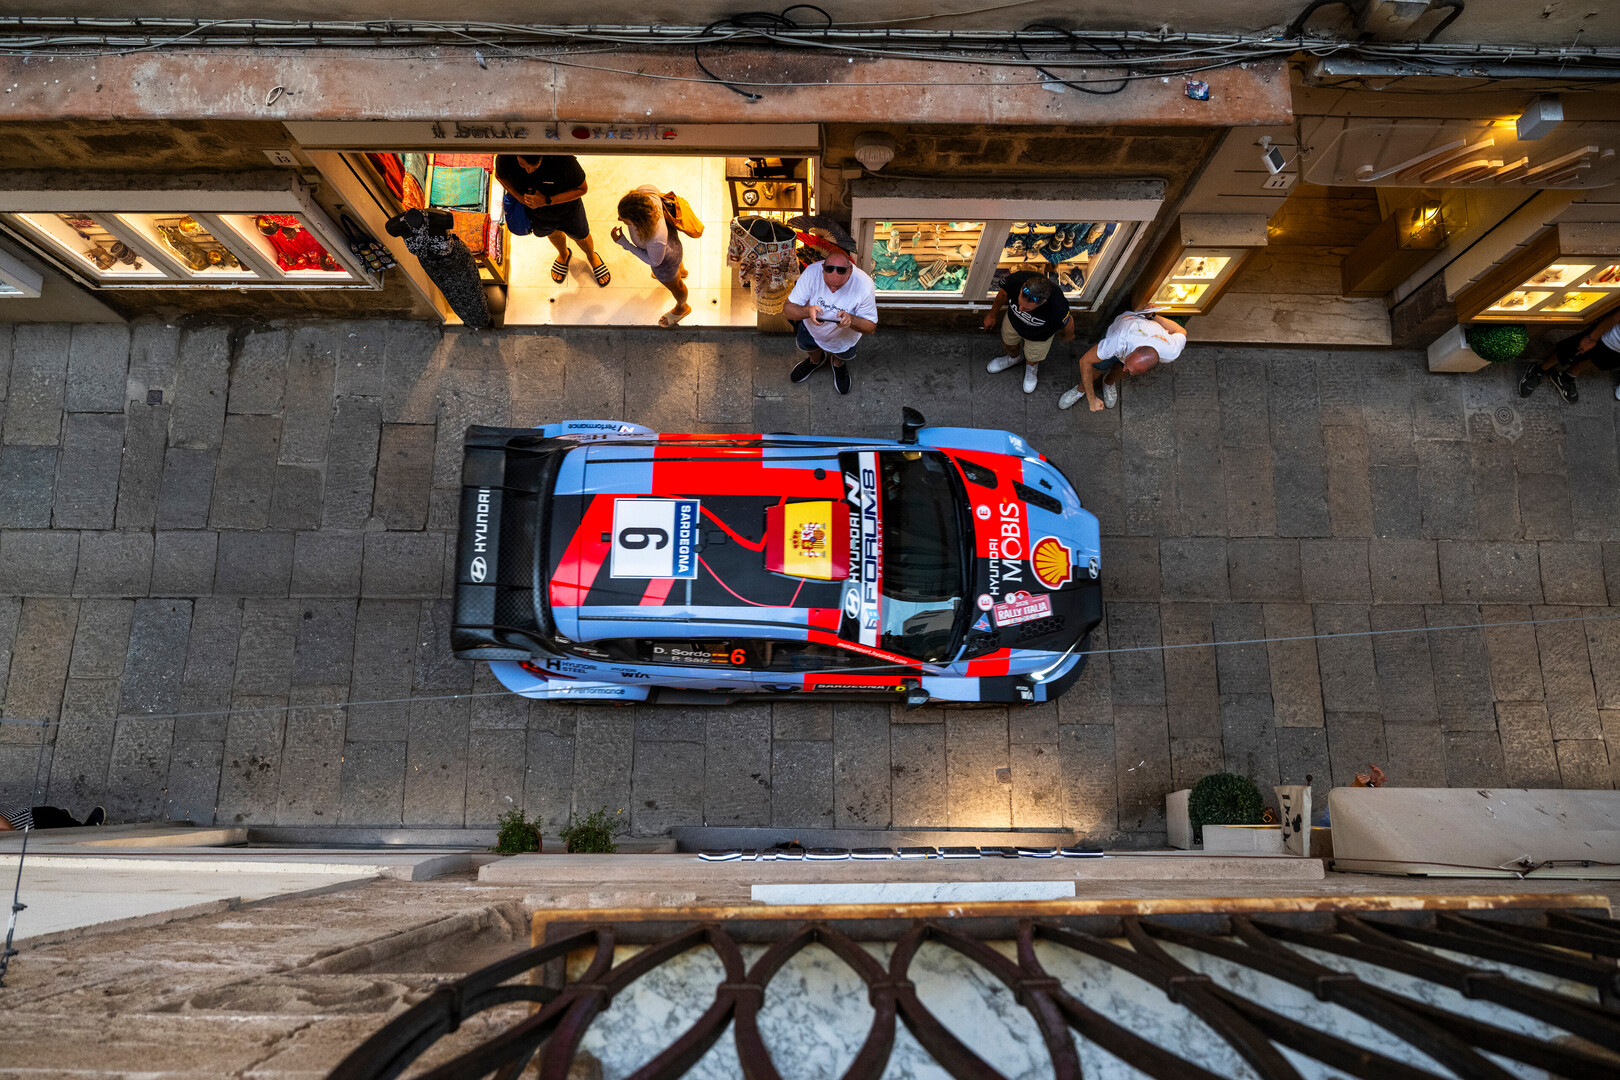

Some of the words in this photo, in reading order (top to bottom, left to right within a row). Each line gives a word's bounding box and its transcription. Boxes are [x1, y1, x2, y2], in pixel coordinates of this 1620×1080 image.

[474, 489, 491, 552] HYUNDAI
[619, 527, 669, 550] 6
[678, 505, 691, 573] SARDEGNA
[849, 512, 860, 583] HYUNDAI
[862, 469, 877, 604] FORUM8
[999, 502, 1022, 582] MOBIS
[989, 538, 1000, 596] HYUNDAI
[981, 597, 990, 605] E
[998, 608, 1022, 620] RALLY
[1023, 601, 1047, 614] ITALIA
[653, 647, 668, 655] D.
[671, 648, 711, 658] Sordo
[730, 648, 746, 665] 6
